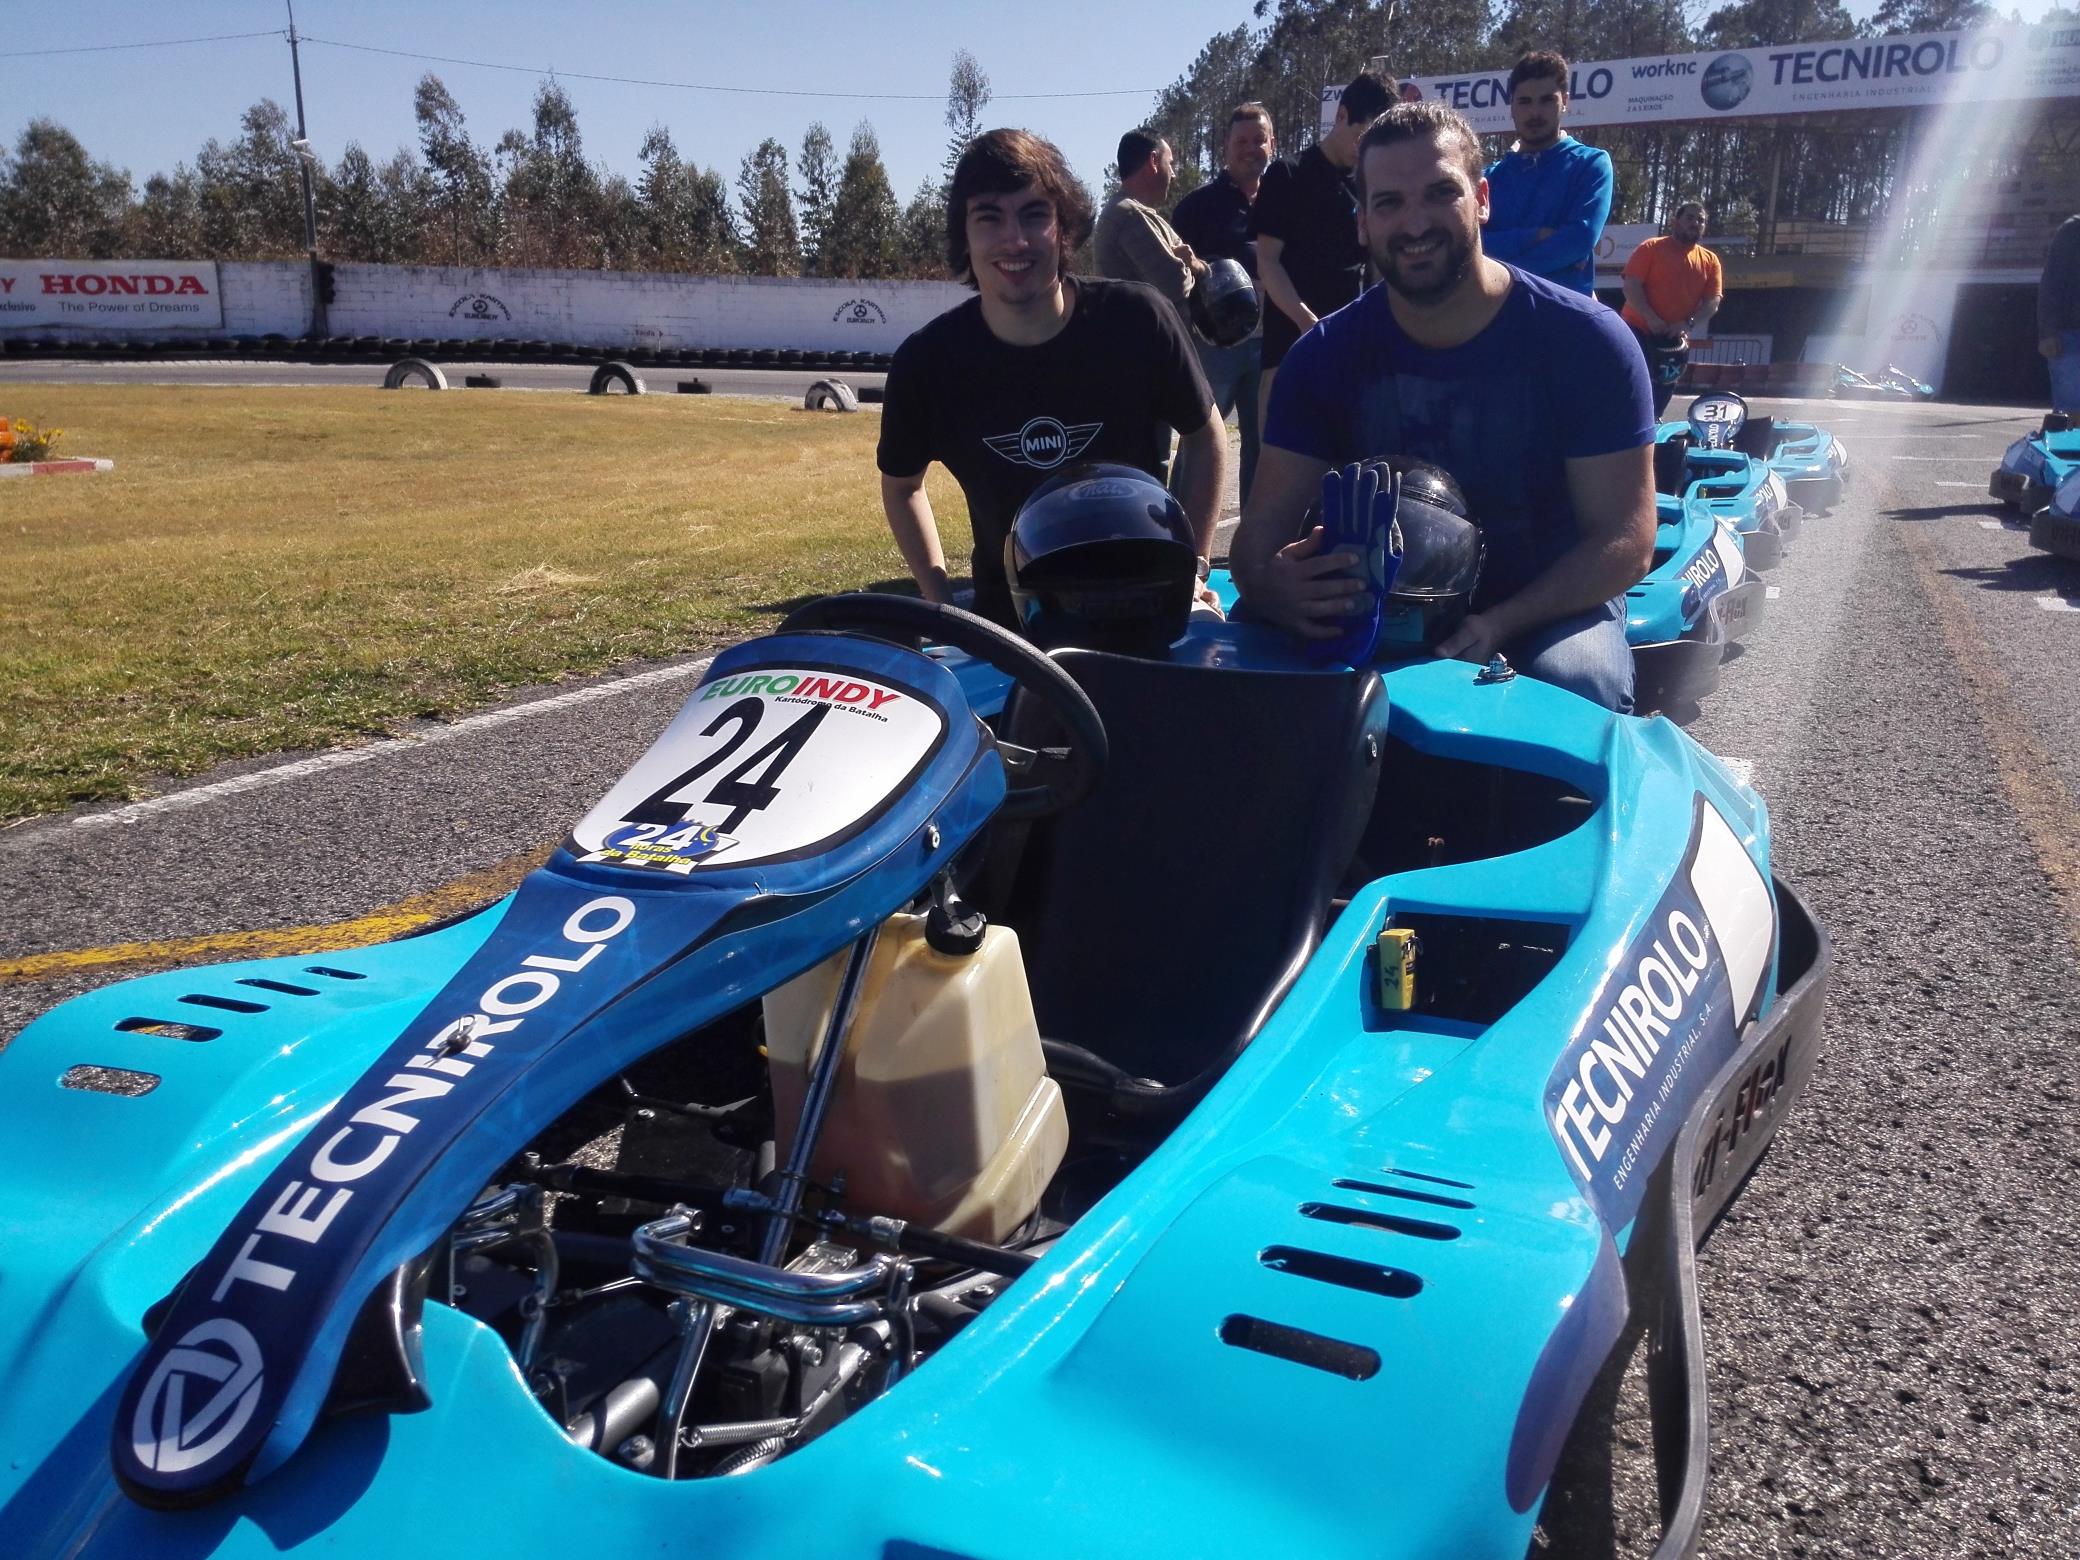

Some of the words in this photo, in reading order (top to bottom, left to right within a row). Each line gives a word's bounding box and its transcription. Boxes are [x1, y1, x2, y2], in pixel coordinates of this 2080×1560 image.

[1632, 58, 1697, 79] worknc
[1769, 36, 2005, 86] TECNIROLO
[1434, 68, 1613, 109] TECNLO
[1791, 90, 1862, 102] ENGENHARIA
[40, 274, 209, 296] HONDA
[60, 302, 84, 313] The
[88, 302, 131, 313] Power
[134, 301, 146, 313] of
[150, 302, 200, 313] Dreams
[1703, 403, 1728, 419] 31
[1025, 437, 1063, 452] MINI
[699, 674, 901, 710] EUROINDY
[833, 703, 848, 712] da
[849, 706, 889, 724] Batalha
[619, 696, 831, 835] 24
[616, 822, 702, 851] 24
[628, 842, 673, 854] horas
[624, 850, 692, 866] Batalha
[1384, 964, 1400, 990] 24
[1554, 910, 1708, 1182] TECNIROLO
[213, 895, 637, 1303] TECNIROLO
[1612, 1100, 1662, 1192] ENGENHARIA
[1658, 1028, 1702, 1102] INDUSTRIAL,
[1698, 1002, 1714, 1027] S.A.
